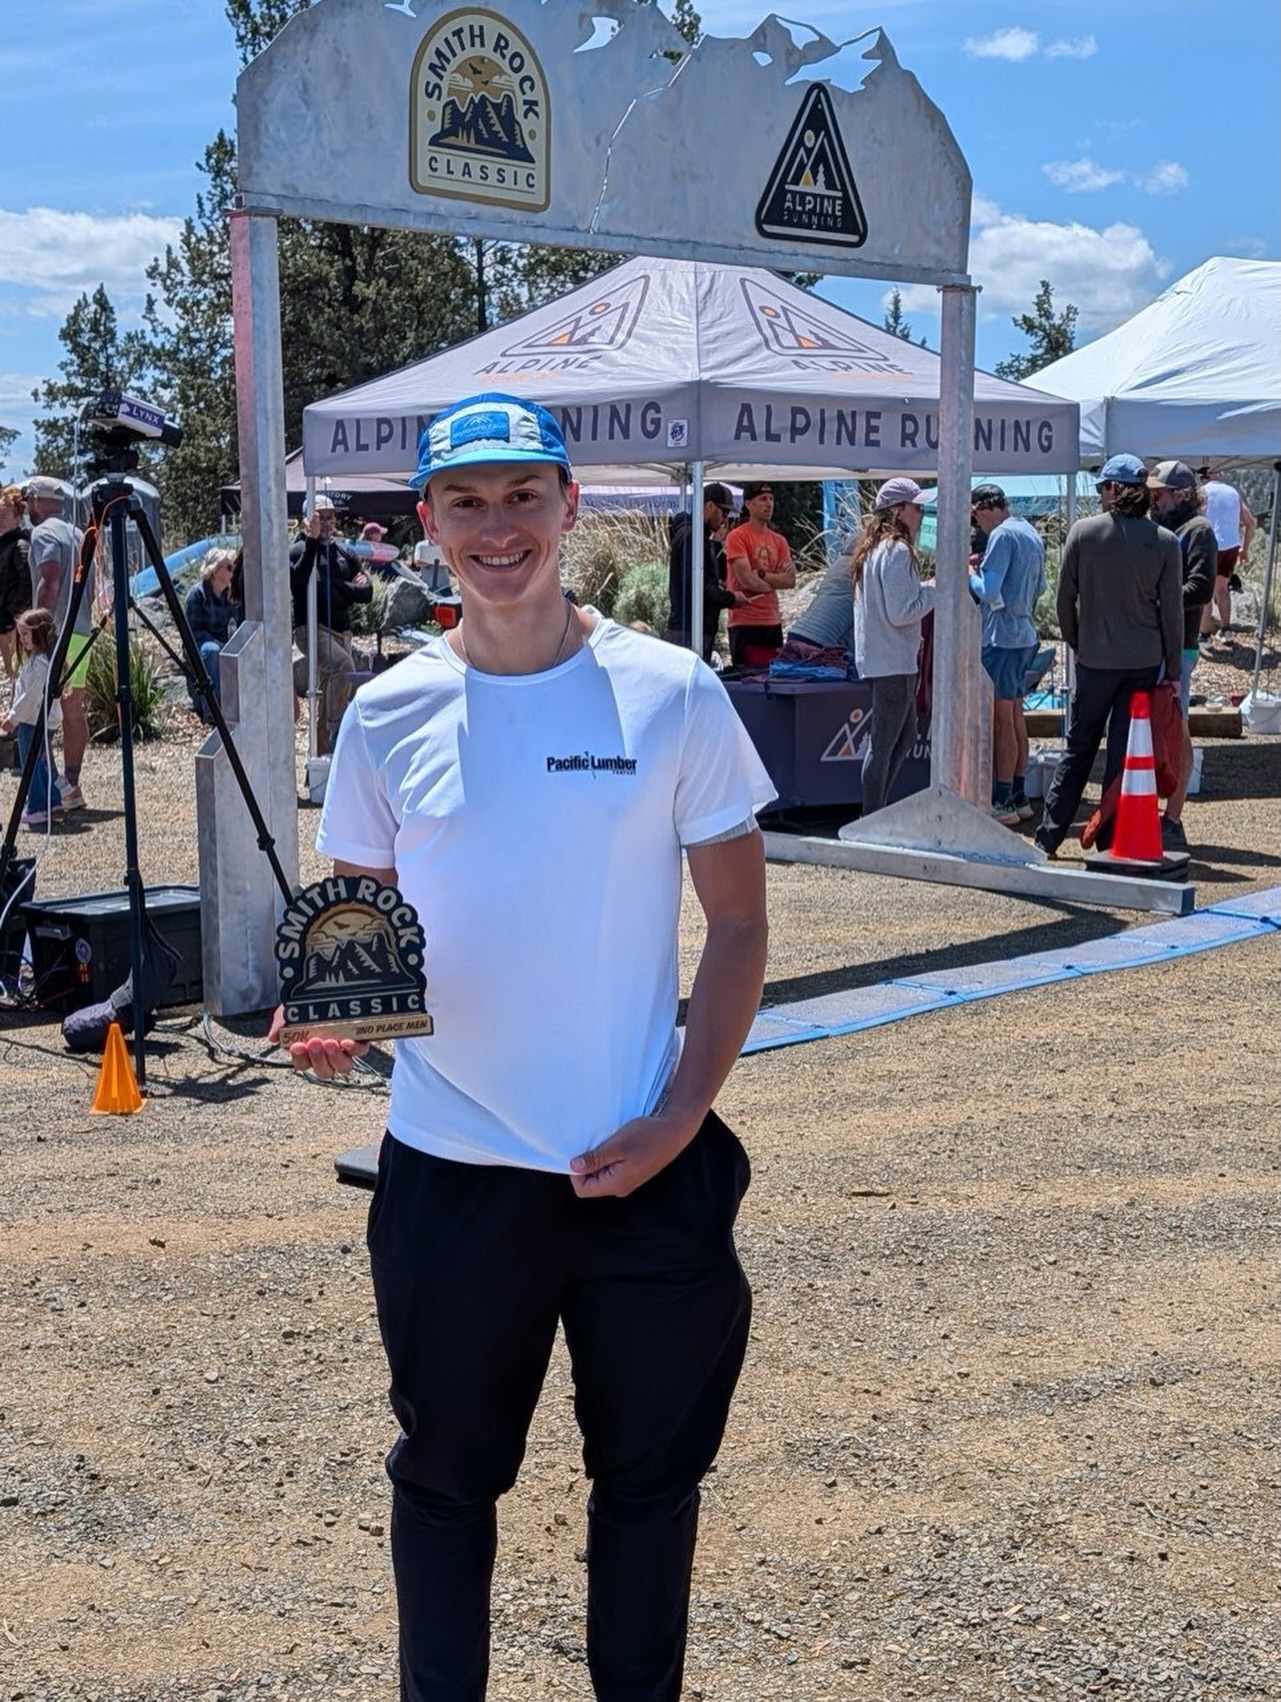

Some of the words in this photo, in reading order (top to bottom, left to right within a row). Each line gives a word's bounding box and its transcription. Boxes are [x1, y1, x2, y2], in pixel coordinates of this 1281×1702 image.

[425, 24, 485, 102] SMITH
[493, 32, 540, 120] ROCK
[428, 156, 536, 188] CLASSIC
[784, 193, 843, 216] ALPINE
[473, 355, 602, 375] ALPINE
[790, 360, 914, 375] ALPINE
[132, 406, 159, 424] LYNX
[733, 403, 882, 448] ALPINE
[900, 413, 1054, 453] RUNING
[547, 755, 590, 773] Pacific
[590, 755, 637, 771] Lumber
[279, 878, 347, 960] SMITH
[356, 879, 421, 948] ROCK
[287, 994, 420, 1022] CLASSIC
[376, 1022, 404, 1032] PLACE
[405, 1020, 428, 1030] MEN
